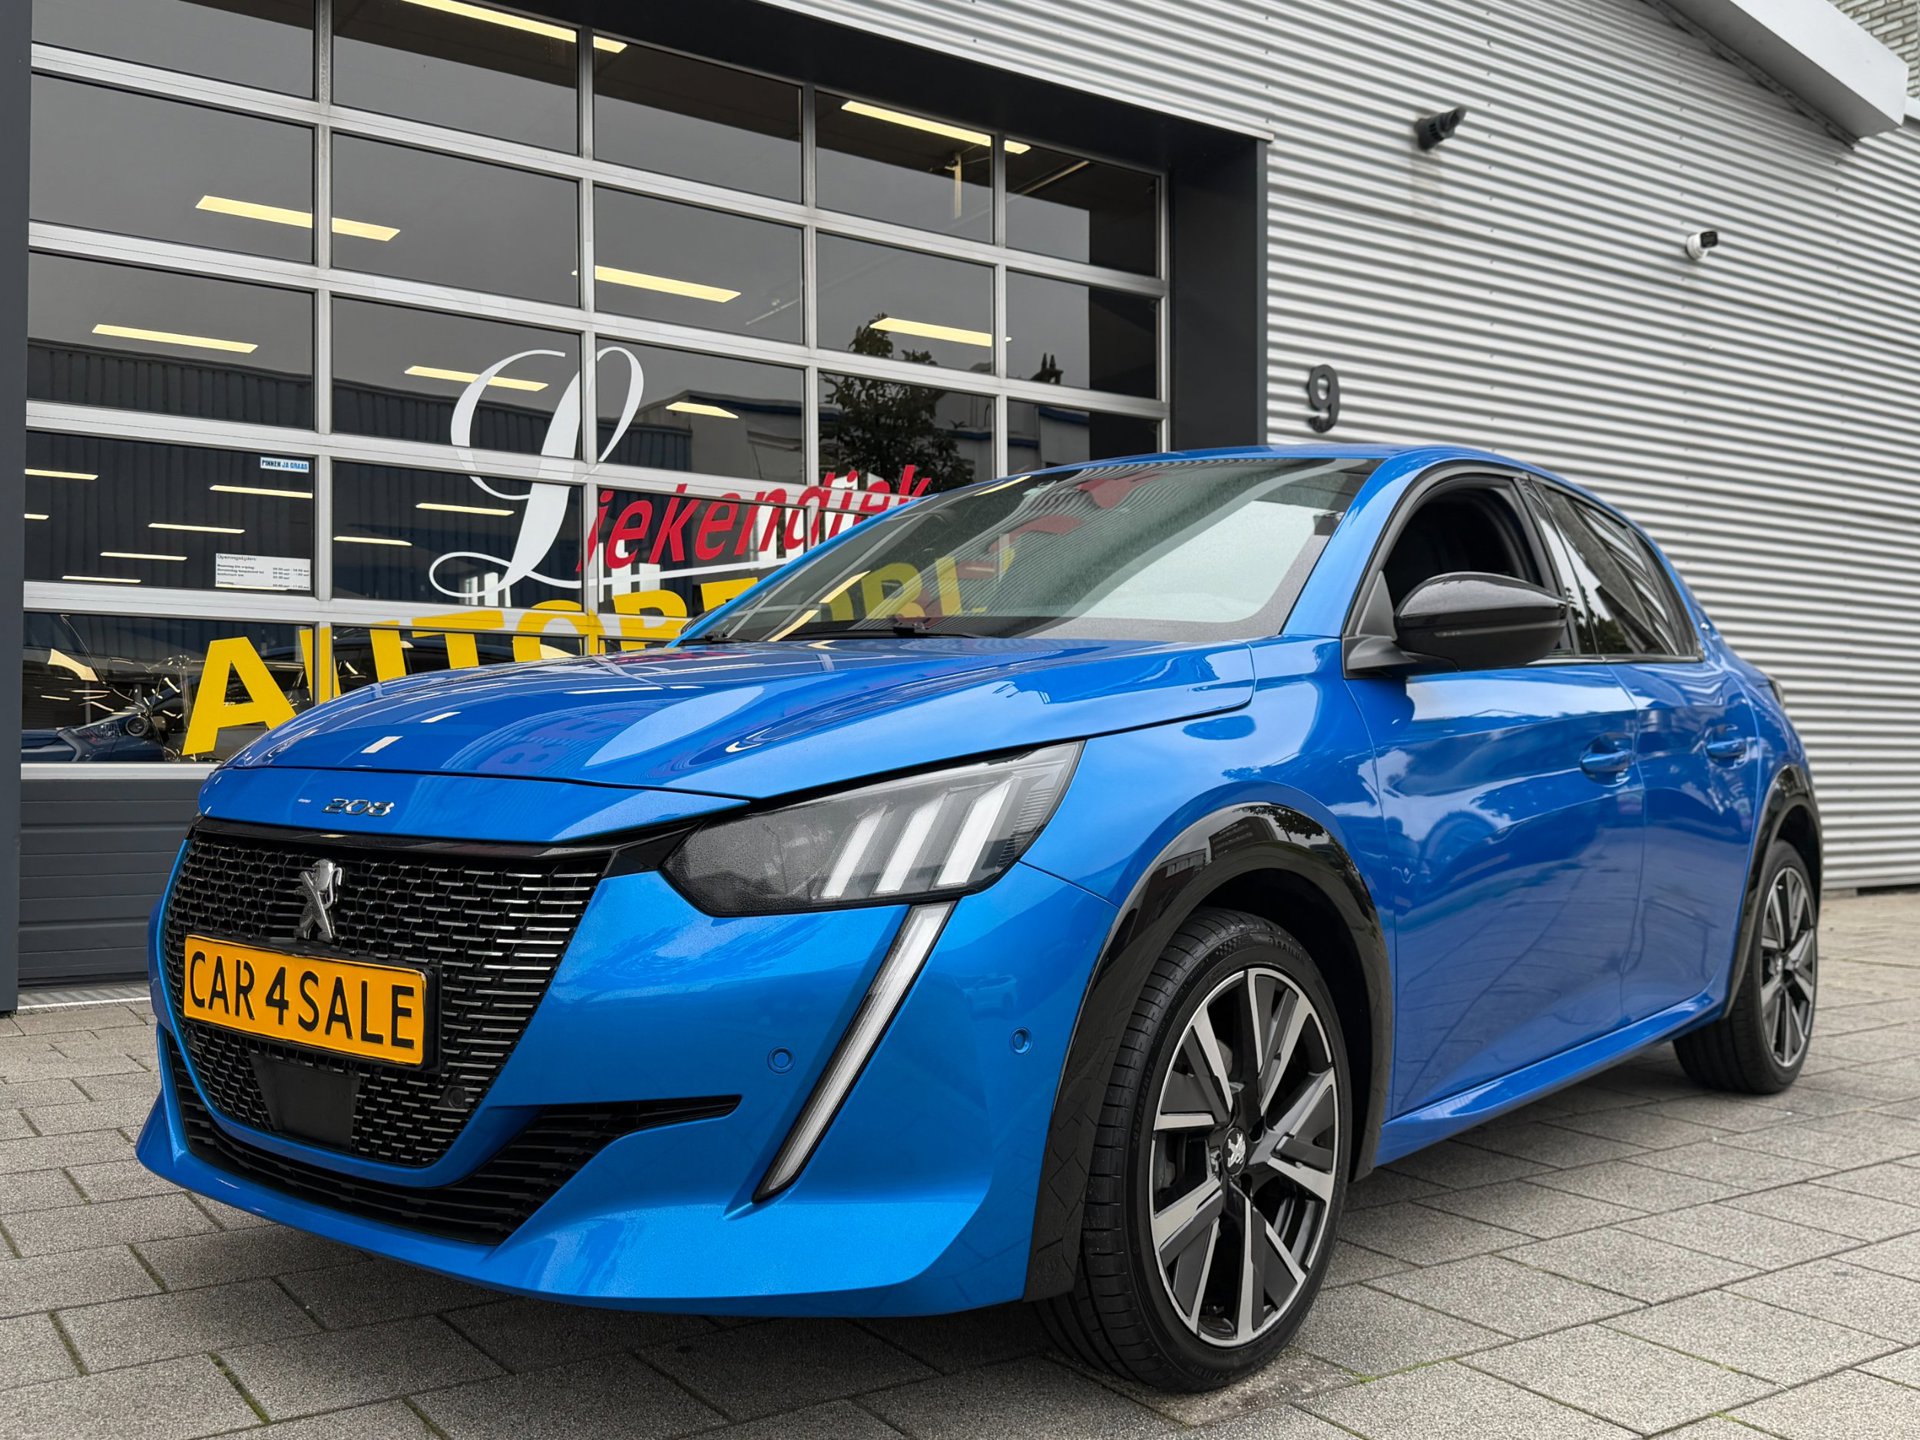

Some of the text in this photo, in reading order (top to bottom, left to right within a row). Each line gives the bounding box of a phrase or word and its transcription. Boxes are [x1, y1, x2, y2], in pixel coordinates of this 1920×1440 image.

[1305, 364, 1341, 433] 9
[322, 797, 395, 817] 208
[190, 951, 416, 1050] CAR 4 SALE
